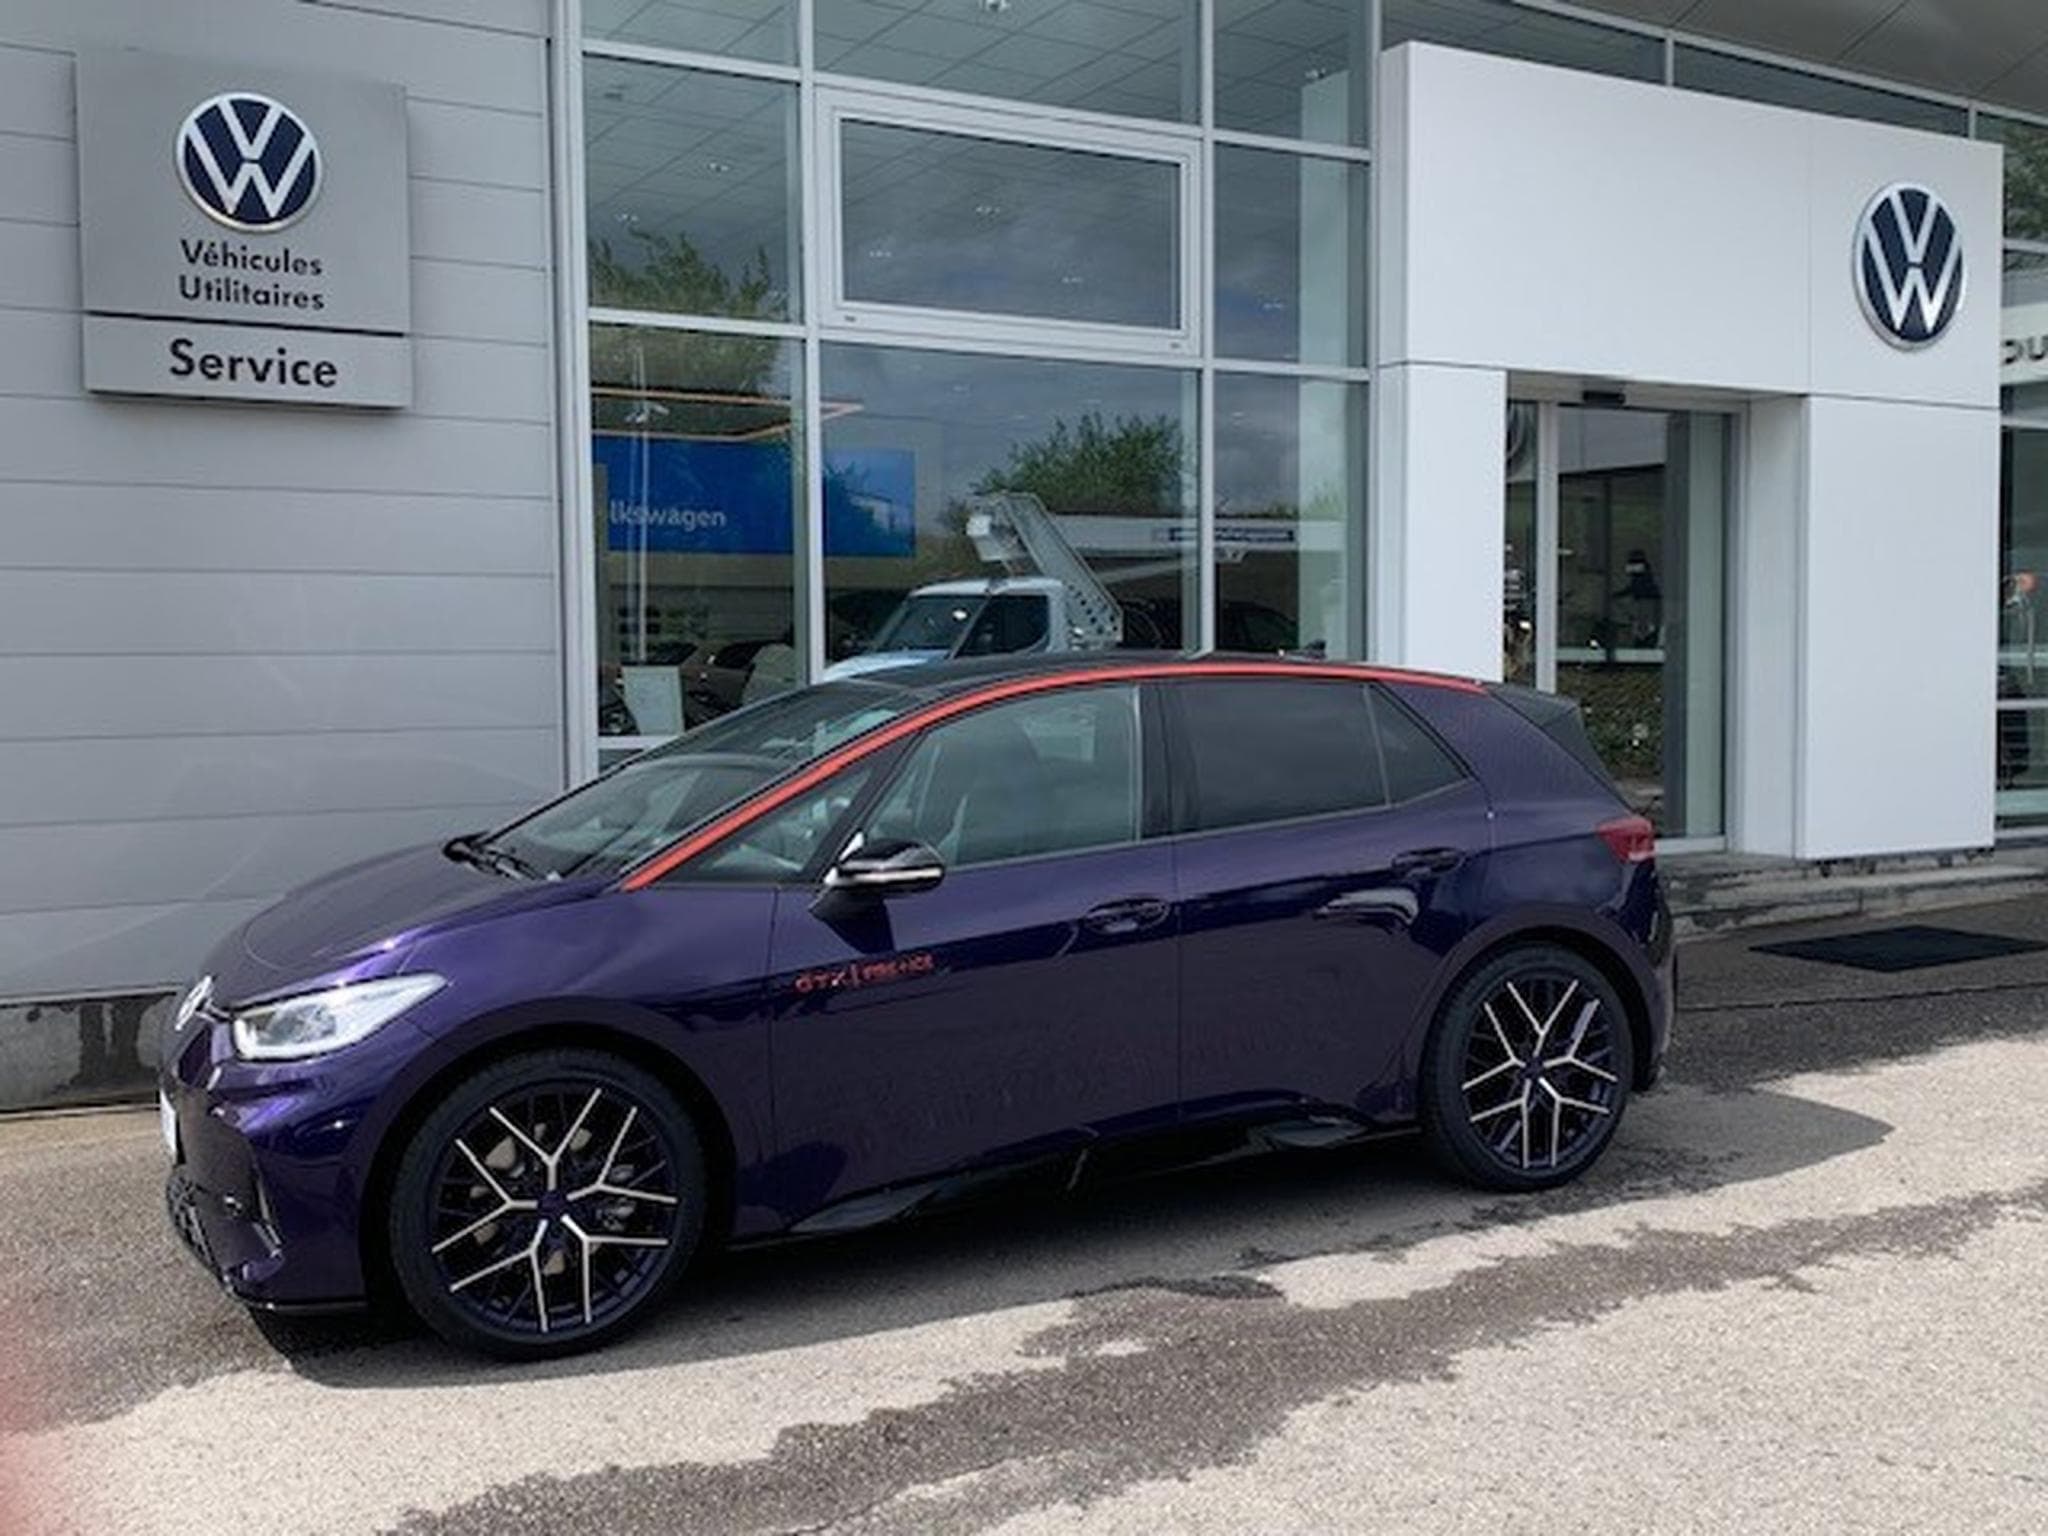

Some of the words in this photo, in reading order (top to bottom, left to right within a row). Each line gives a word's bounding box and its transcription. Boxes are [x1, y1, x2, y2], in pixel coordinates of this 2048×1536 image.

[177, 94, 320, 226] VW
[180, 238, 323, 276] Véhicules
[1856, 185, 1966, 340] VW
[178, 274, 325, 310] Utilitaires
[169, 338, 338, 388] Service
[609, 499, 728, 533] lkswagen
